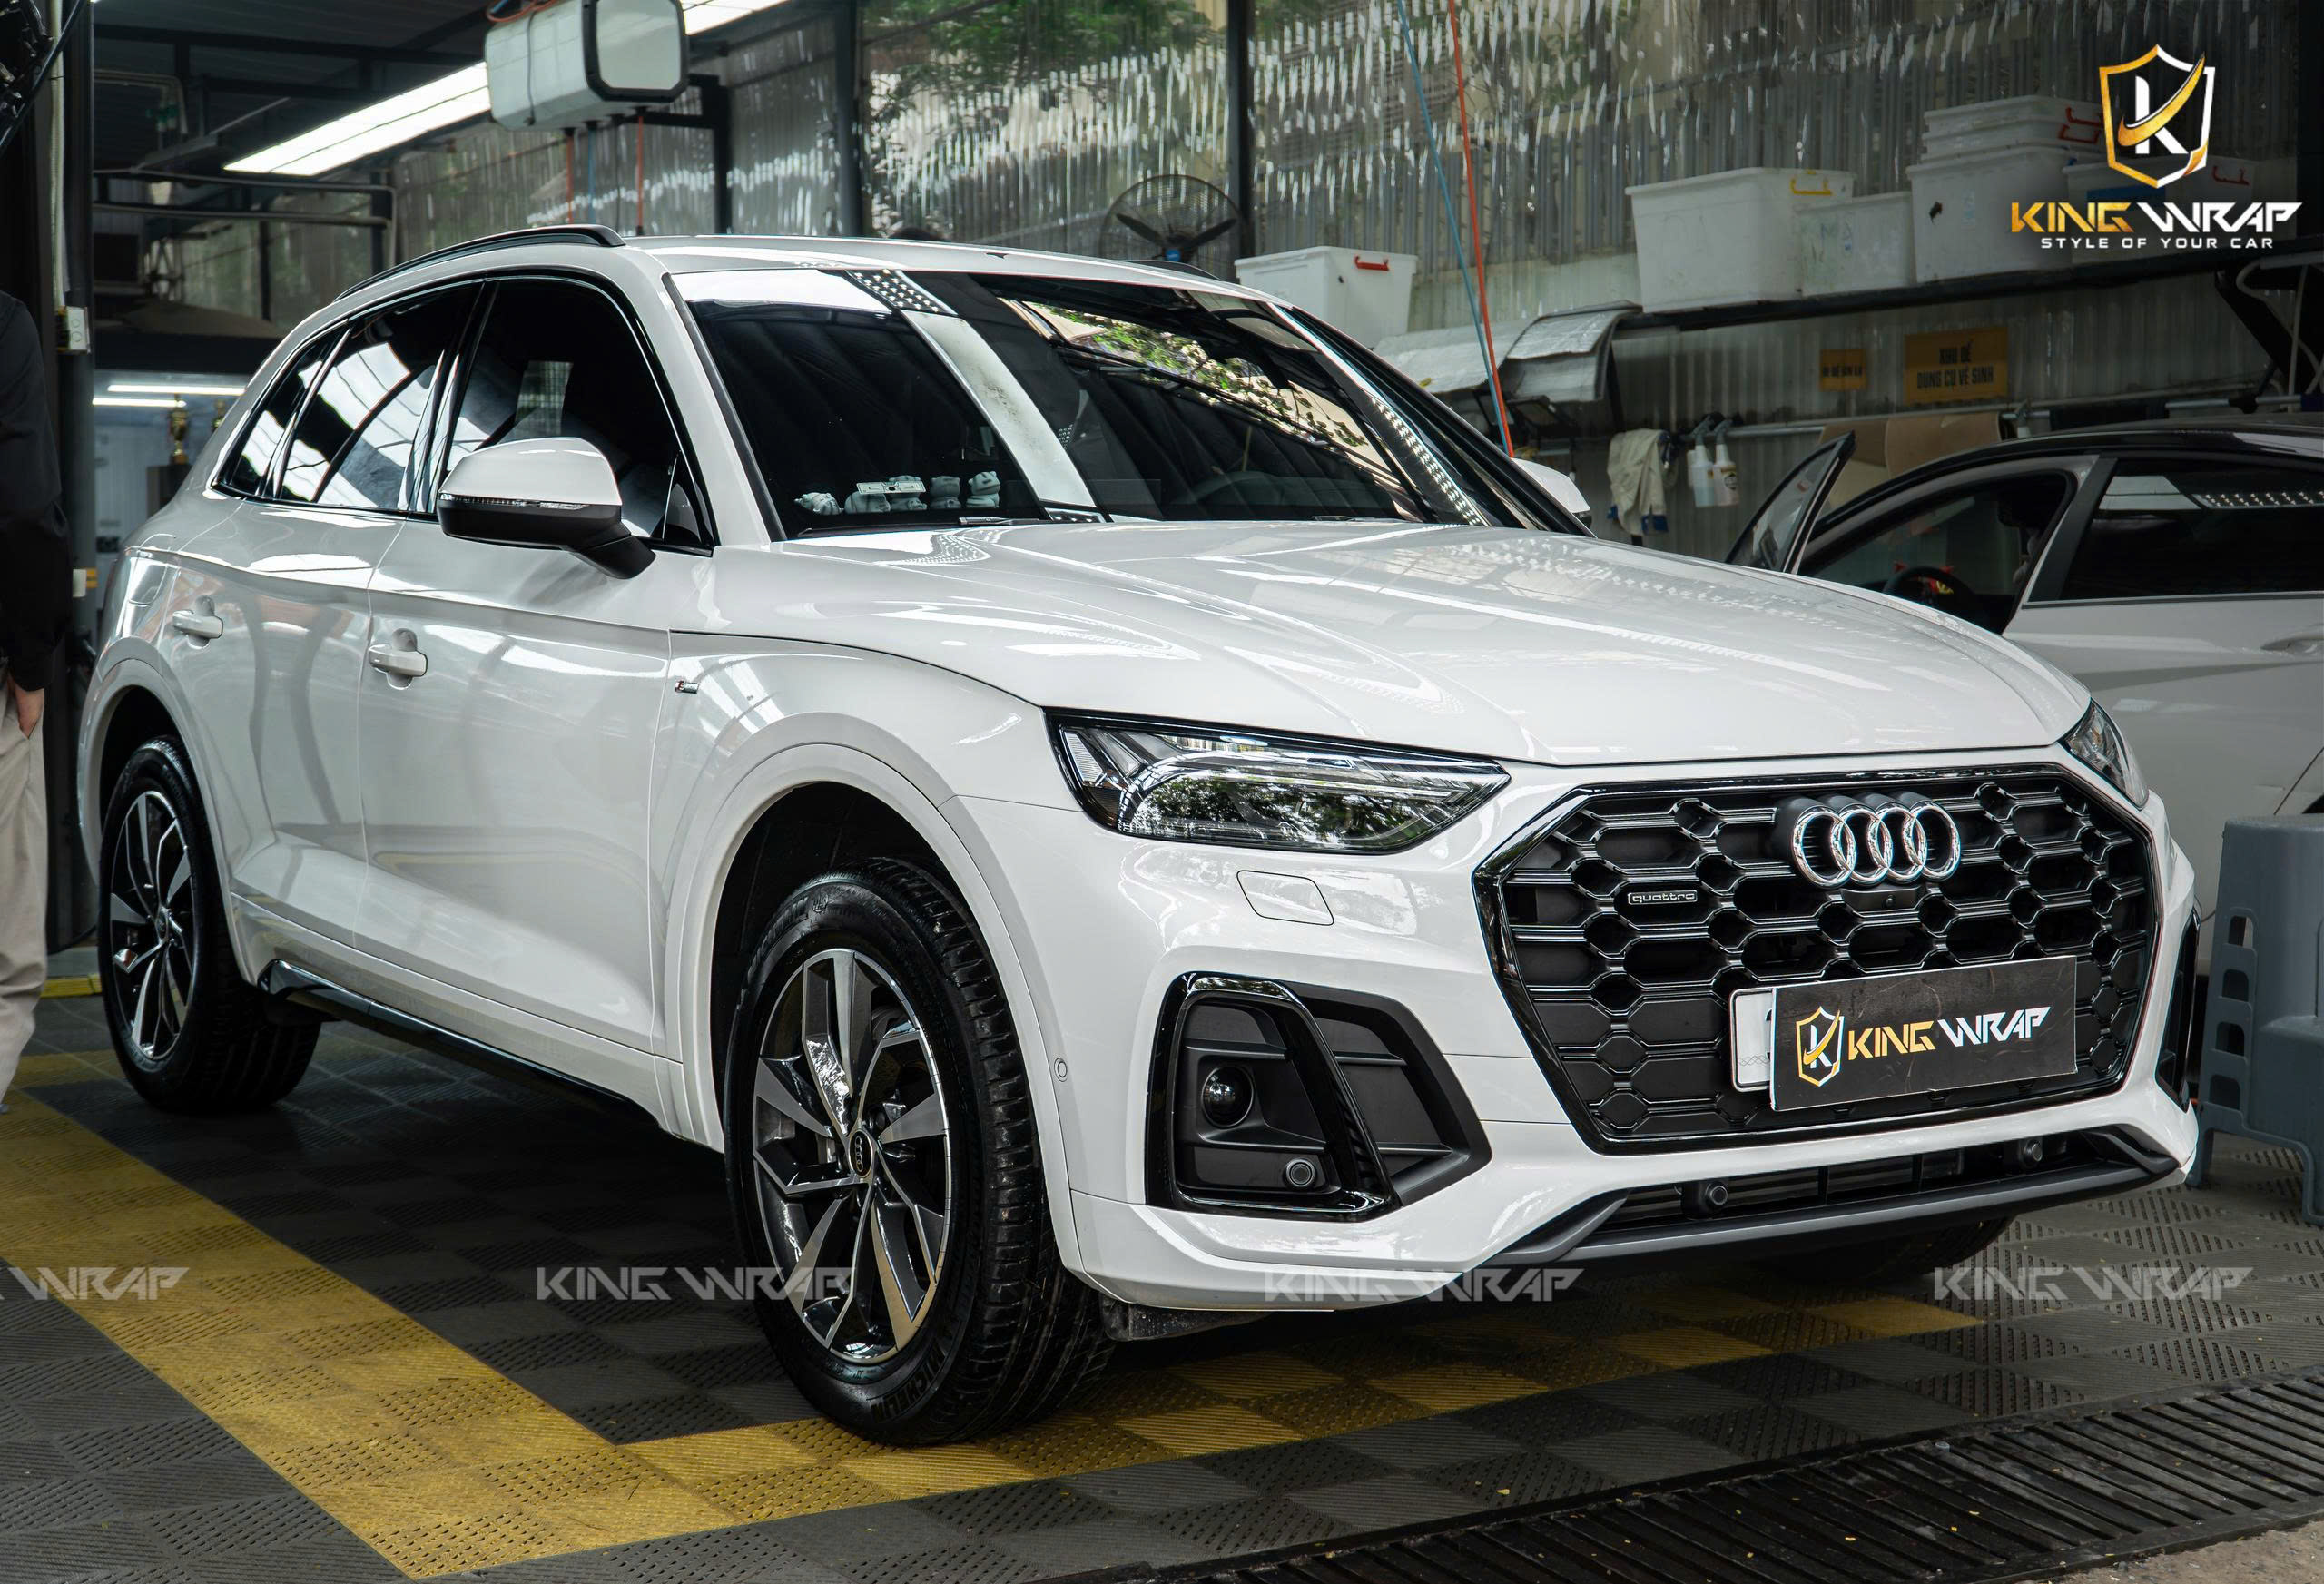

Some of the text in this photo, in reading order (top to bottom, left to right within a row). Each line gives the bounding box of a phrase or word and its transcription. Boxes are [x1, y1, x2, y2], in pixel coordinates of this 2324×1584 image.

[1631, 892, 1696, 904] quattro
[1848, 1006, 2052, 1061] KING WRAP
